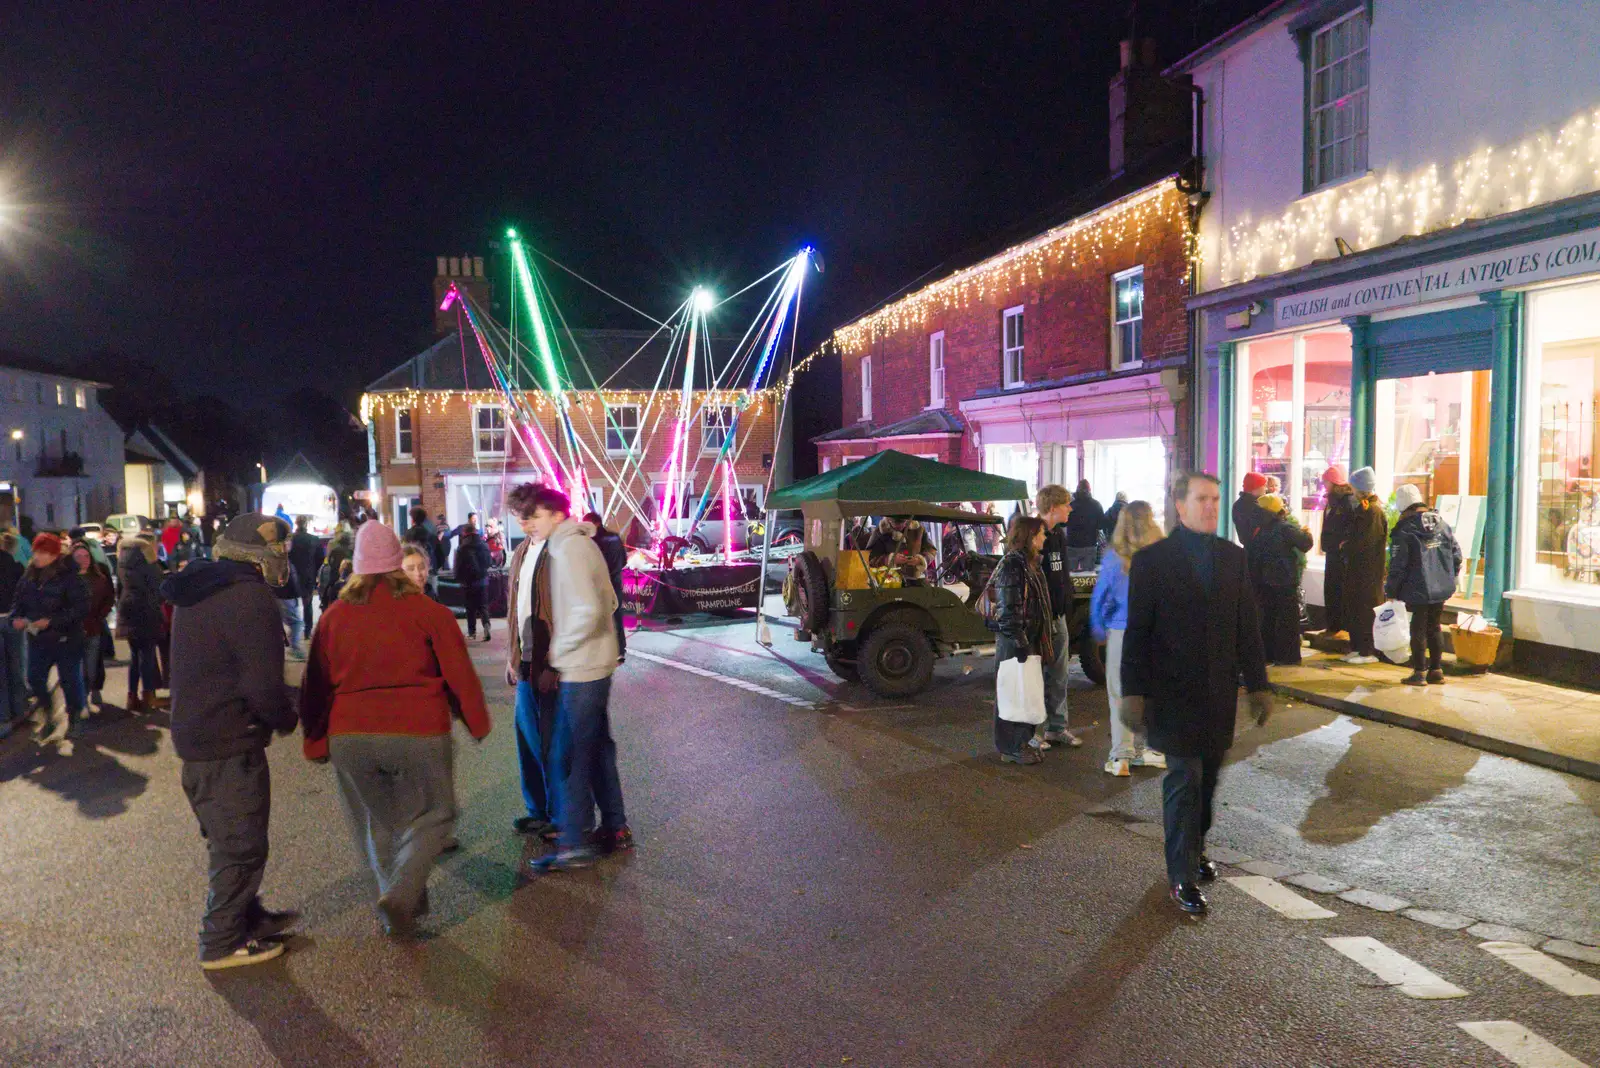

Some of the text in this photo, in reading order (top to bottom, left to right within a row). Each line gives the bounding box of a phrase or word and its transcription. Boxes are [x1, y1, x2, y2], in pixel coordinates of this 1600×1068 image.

[1282, 297, 1329, 320] ENGLISH
[1331, 292, 1351, 310] and
[1354, 271, 1450, 305] CONTINENTAL
[1455, 252, 1541, 283] ANTIQUES
[696, 598, 742, 611] TRAMPOLINE
